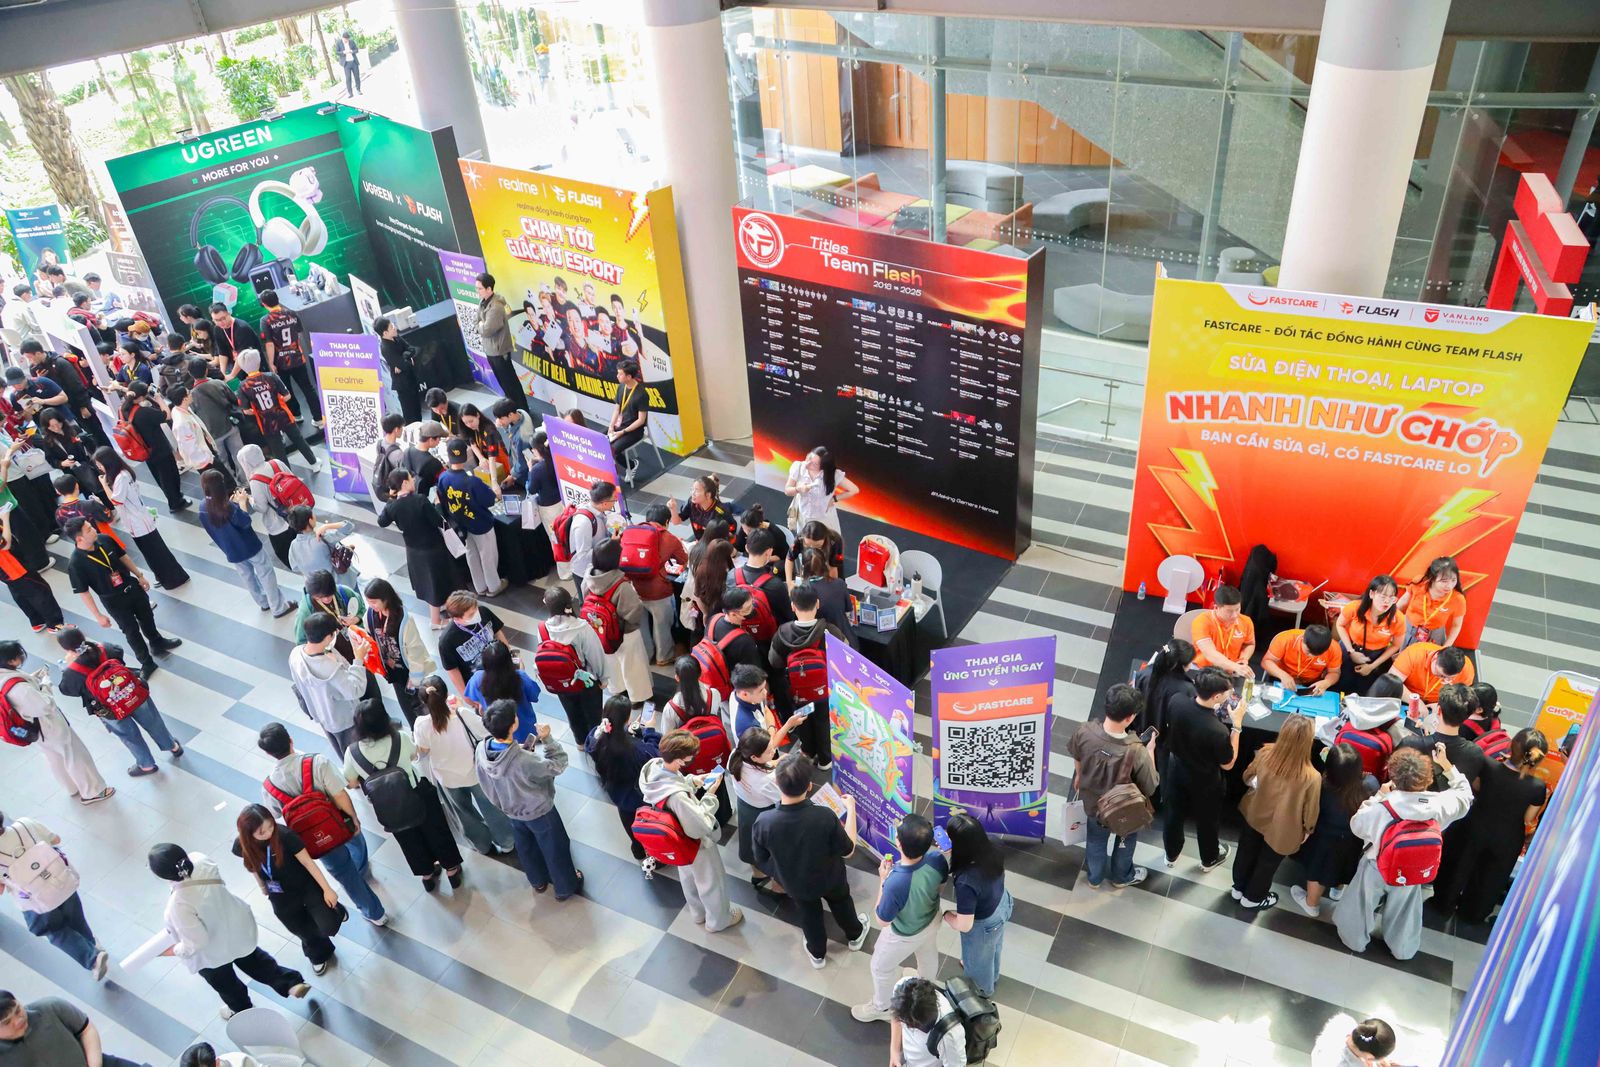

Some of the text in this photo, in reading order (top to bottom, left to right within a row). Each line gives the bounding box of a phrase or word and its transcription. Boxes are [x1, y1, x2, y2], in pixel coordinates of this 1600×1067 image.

[181, 126, 272, 164] UGREEN
[202, 156, 270, 182] MORE FOR YOU
[498, 178, 538, 196] realme
[362, 180, 394, 203] UGREEN
[416, 202, 443, 224] FLASH
[568, 191, 602, 209] FLASH
[520, 216, 595, 252] CHẠM TỚI
[810, 236, 849, 254] Titles
[505, 235, 624, 286] GIẤC MƠ ESPORT
[820, 252, 923, 287] Team Flash
[900, 286, 922, 296] 2025
[1269, 296, 1319, 308] FASTCARE
[1357, 305, 1400, 318] FLASH
[1442, 312, 1489, 323] VANLANG
[281, 327, 291, 347] 9
[1204, 320, 1262, 334] FASTCARE
[1274, 324, 1297, 338] ĐỐI
[1300, 328, 1323, 340] TÁC
[1327, 330, 1364, 345] ĐỒNG
[1367, 333, 1402, 349] HÀNH
[1405, 338, 1441, 353] CÙNG
[1445, 344, 1480, 358] TEAM
[1482, 348, 1523, 362] FLASH
[319, 349, 334, 357] ỨNG
[334, 350, 355, 358] TUYỂN
[1229, 352, 1485, 398] SỬA ĐIỆN THOẠI, LAPTOP
[256, 390, 274, 411] 18
[561, 430, 592, 447] THAM GIA
[1168, 394, 1519, 476] NHANH NHƯ CHỚP
[552, 435, 606, 460] ỨNG TUYỂN NGAY
[1201, 429, 1232, 448] BẠN
[1235, 429, 1269, 449] CẦN
[1273, 436, 1304, 454] SỬA
[1334, 444, 1360, 461] CÓ
[1364, 452, 1446, 472] FASTCARE
[1448, 462, 1471, 475] LO
[965, 653, 1023, 667] THAM GIA
[943, 662, 1044, 681] ỨNG TUYỂN NGAY
[978, 696, 1034, 711] FASTCARE
[870, 789, 884, 803] DAY
